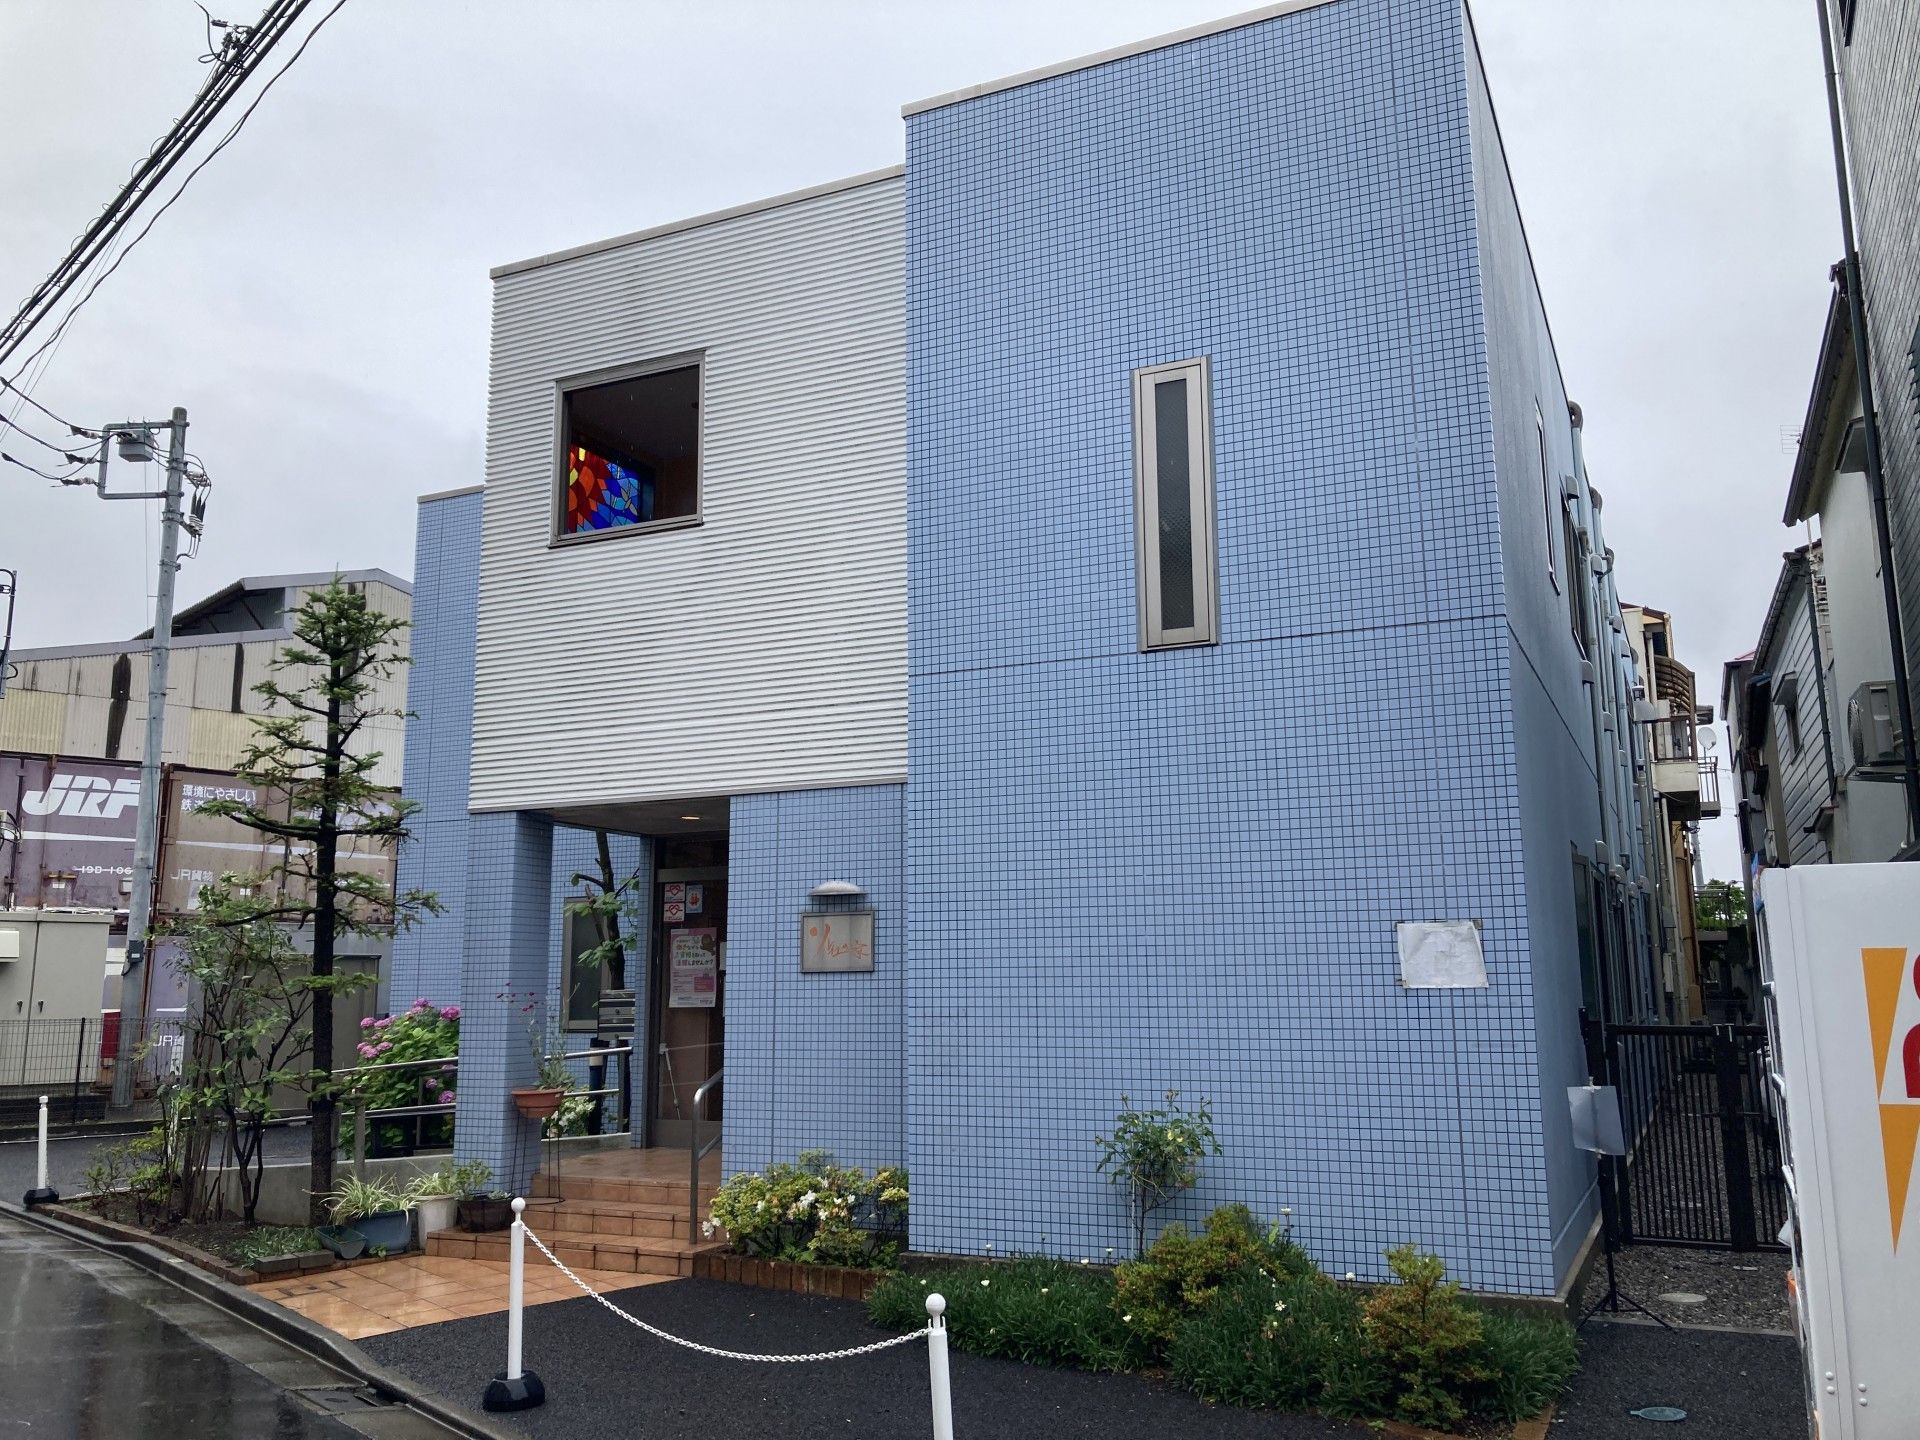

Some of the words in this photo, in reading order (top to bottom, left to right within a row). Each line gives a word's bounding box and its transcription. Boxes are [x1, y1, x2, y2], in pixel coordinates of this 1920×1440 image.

[22, 774, 140, 818] JRF
[182, 785, 256, 801] 環境にやさしい
